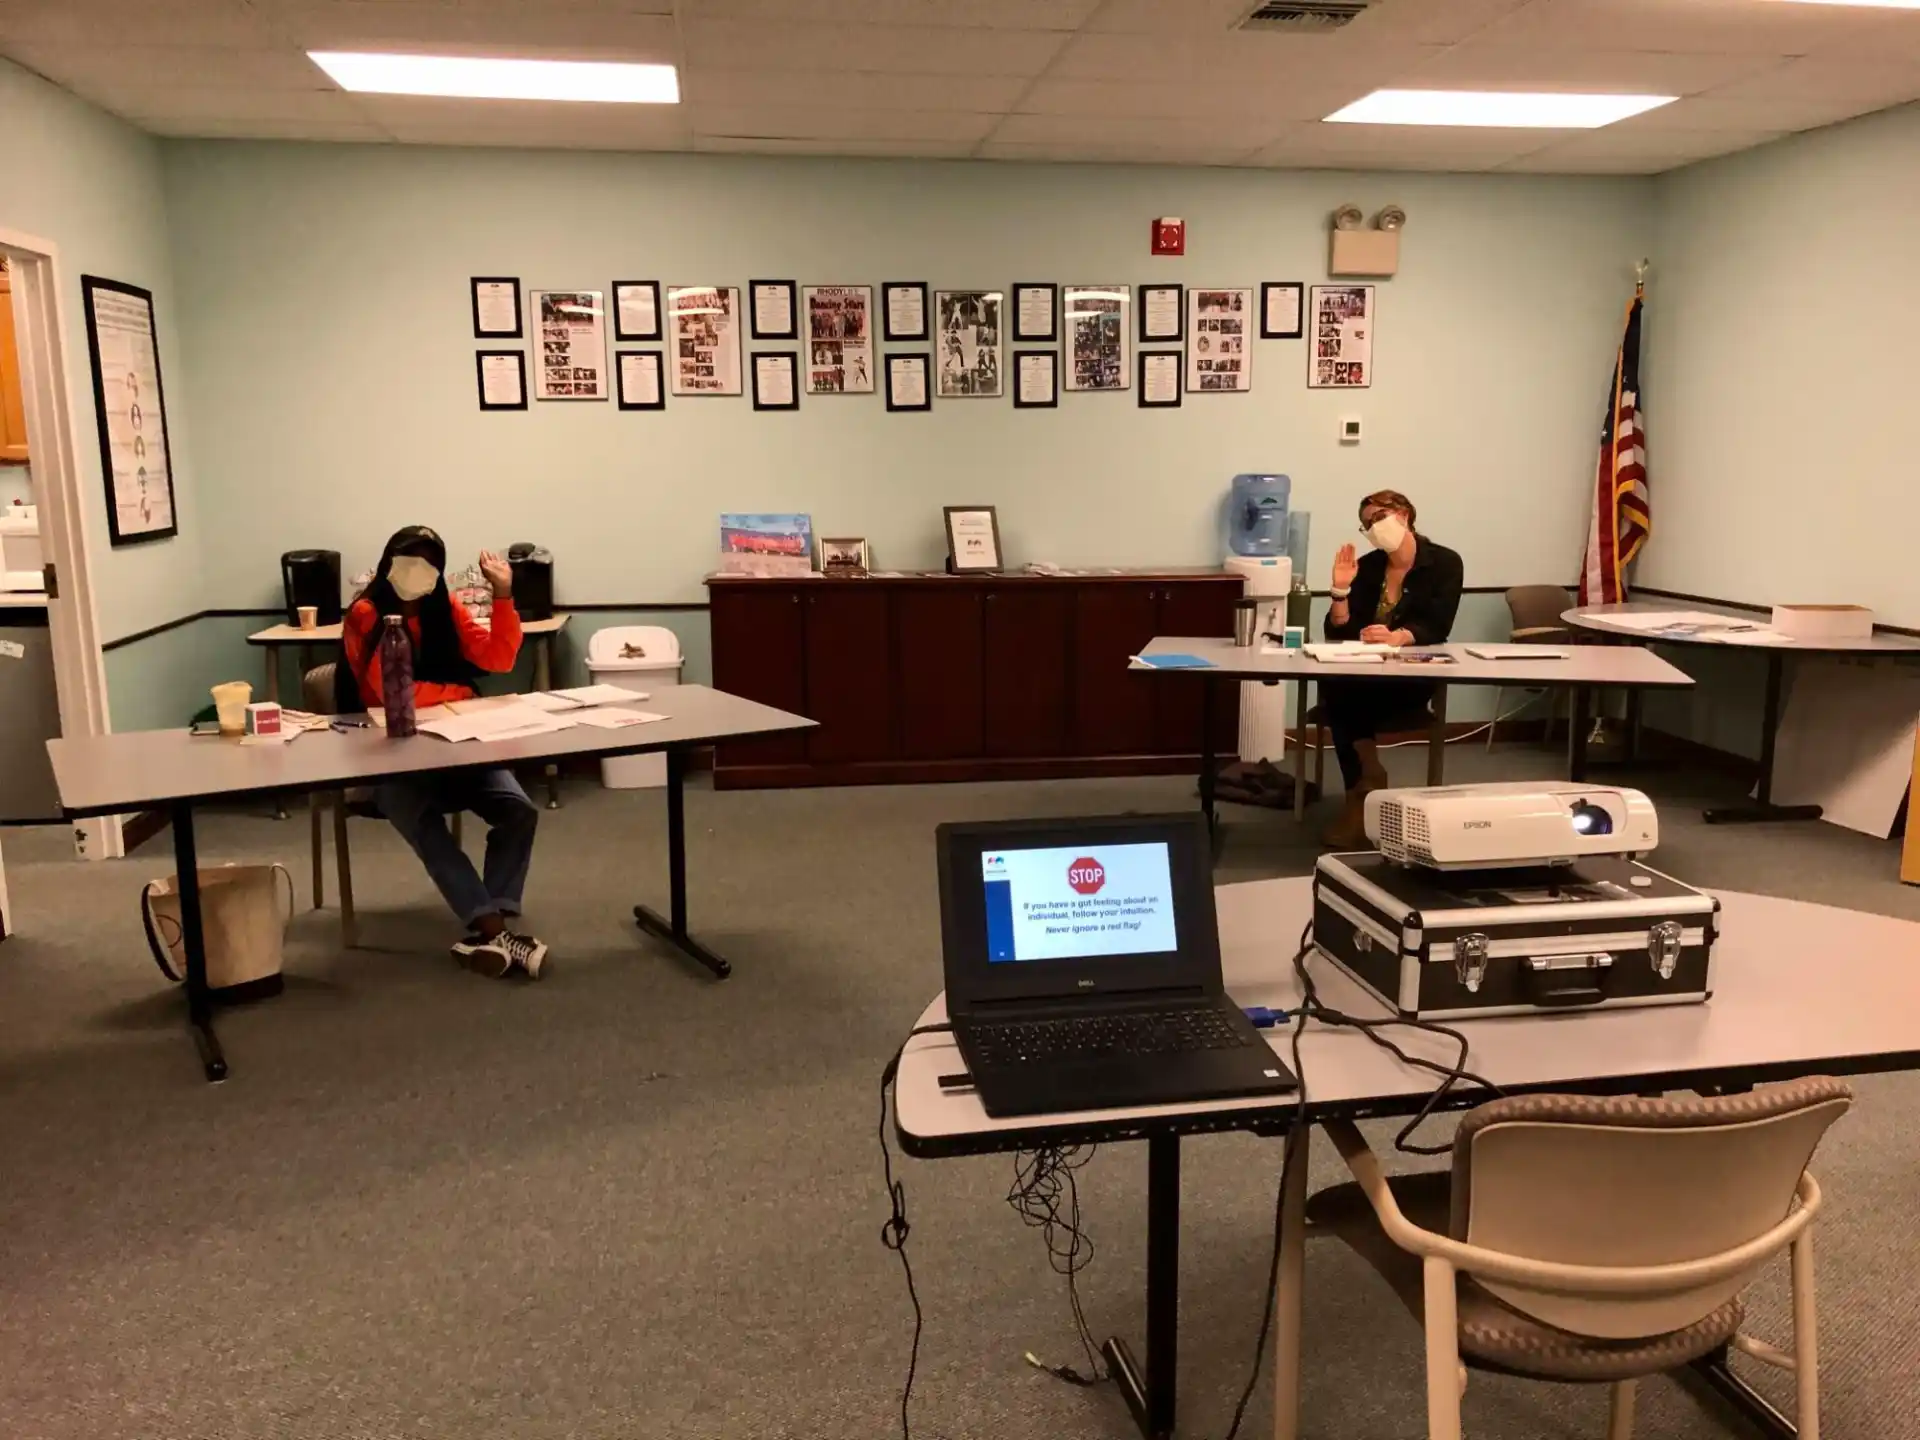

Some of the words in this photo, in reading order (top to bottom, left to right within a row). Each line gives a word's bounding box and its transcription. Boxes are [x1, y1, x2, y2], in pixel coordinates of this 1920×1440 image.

[1463, 821, 1492, 829] EPSON
[1070, 868, 1103, 884] STOP
[1031, 902, 1047, 912] you
[1048, 900, 1069, 909] have
[1077, 899, 1092, 909] gut
[1093, 898, 1122, 907] feeling
[1123, 896, 1147, 905] about
[1072, 909, 1098, 919] follow
[1099, 908, 1119, 919] your
[1045, 925, 1070, 934] Never
[1072, 924, 1099, 934] ignore
[1107, 921, 1122, 931] red
[1123, 919, 1142, 931] flag!
